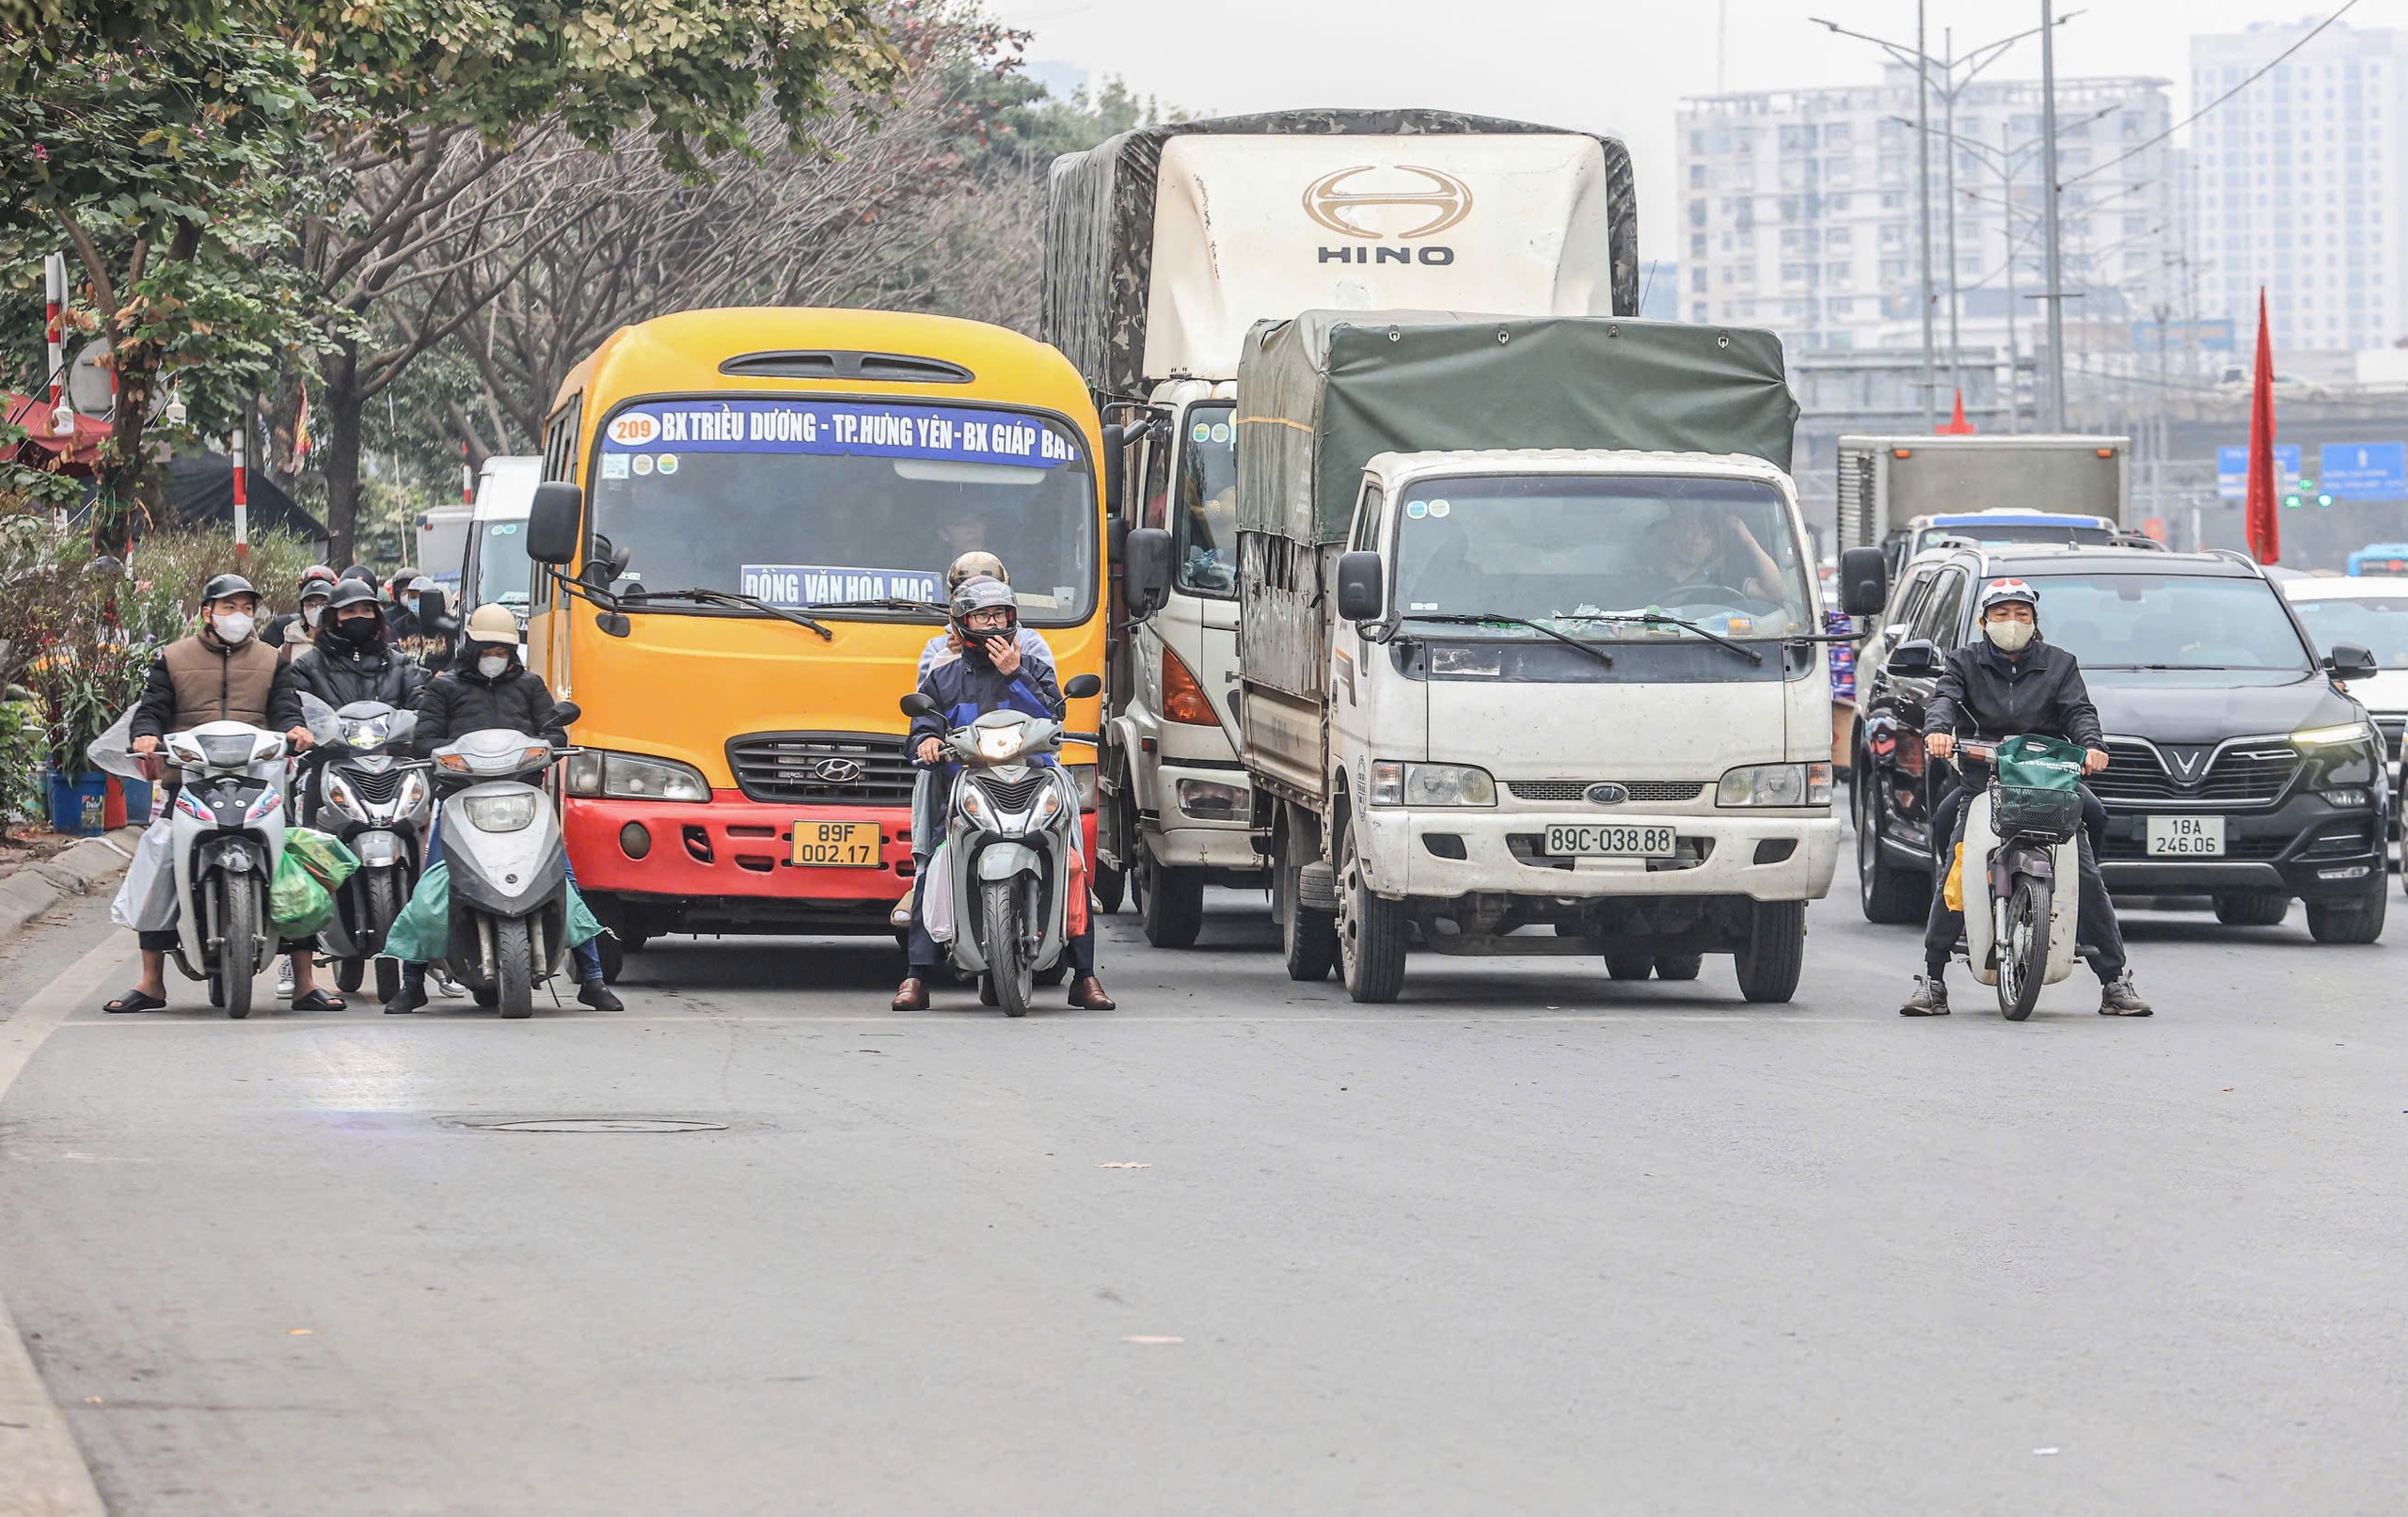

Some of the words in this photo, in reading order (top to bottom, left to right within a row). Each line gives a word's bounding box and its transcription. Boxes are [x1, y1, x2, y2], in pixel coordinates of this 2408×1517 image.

[1318, 246, 1454, 265] HINO
[617, 419, 652, 439] 209
[661, 411, 689, 441] BX
[689, 403, 745, 441] TRIỀU
[750, 408, 817, 442] DƯƠNG
[991, 420, 1037, 456] GIÁP
[745, 568, 799, 603] ĐỒNG
[804, 570, 843, 603] VĂN
[846, 571, 885, 603] HÒA
[818, 824, 856, 843] 89F
[2172, 819, 2202, 835] 18A
[1552, 828, 1671, 852] 89C-038.88
[2156, 837, 2215, 853] 246.06
[802, 844, 870, 863] 002.17
